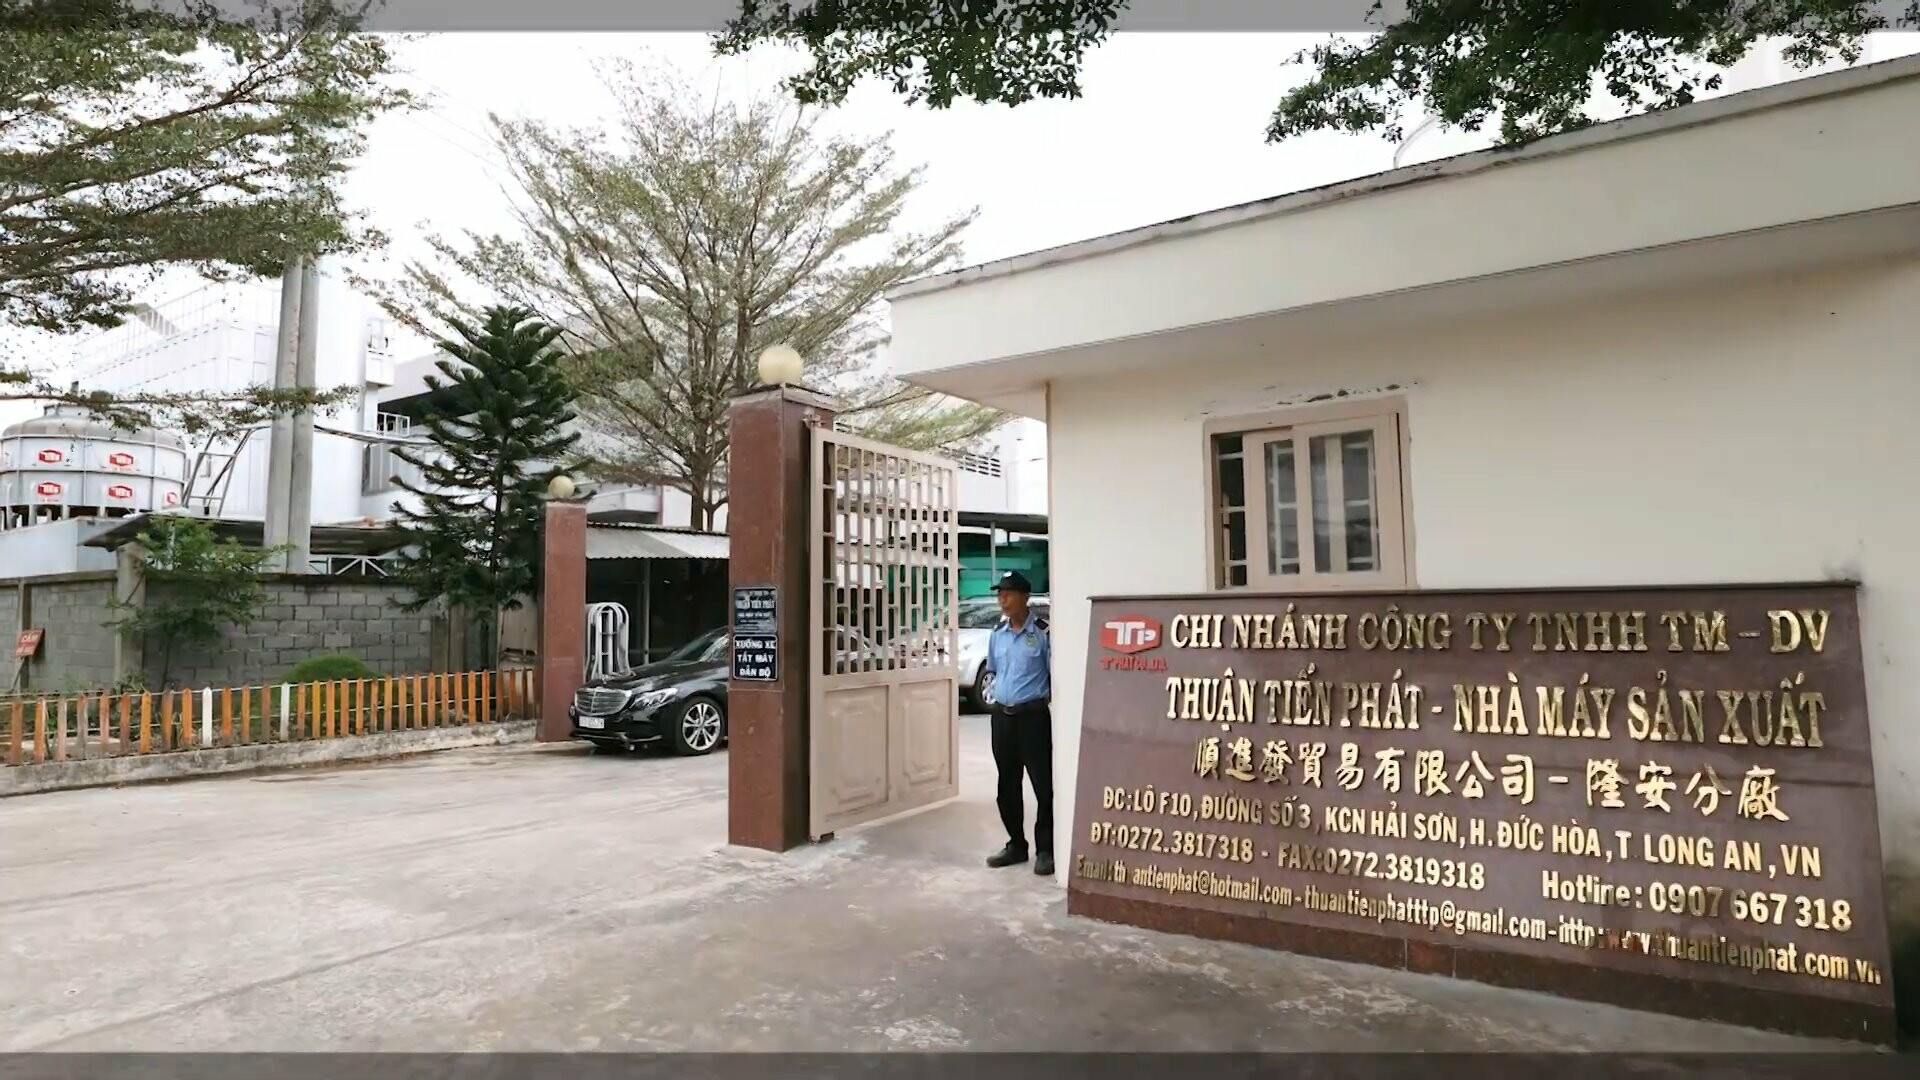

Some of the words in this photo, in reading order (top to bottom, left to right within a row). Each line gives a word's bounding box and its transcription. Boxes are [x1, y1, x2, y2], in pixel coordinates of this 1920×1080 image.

[1170, 613, 1223, 649] CHI
[1231, 602, 1348, 650] NHÁNH
[1357, 603, 1452, 650] CÔNG
[1464, 611, 1517, 652] TY
[1527, 610, 1648, 652] TNHH
[1660, 610, 1730, 652] TM
[1767, 609, 1831, 653] DV
[1166, 667, 1257, 731] THUẬN
[1263, 662, 1334, 727] TIẾN
[1340, 669, 1422, 730] PHÁT
[1453, 671, 1530, 735] NHÀ
[1536, 672, 1616, 739] MÁY
[1627, 670, 1705, 744] SẢN
[1716, 670, 1826, 748] XUẤT
[1325, 806, 1366, 834] KCN
[1371, 801, 1408, 839] HẢI
[1643, 833, 1715, 868] LONG
[1780, 844, 1822, 878] VN
[1648, 881, 1724, 917] 0907
[1730, 888, 1788, 926] 667
[1794, 894, 1852, 933] 318
